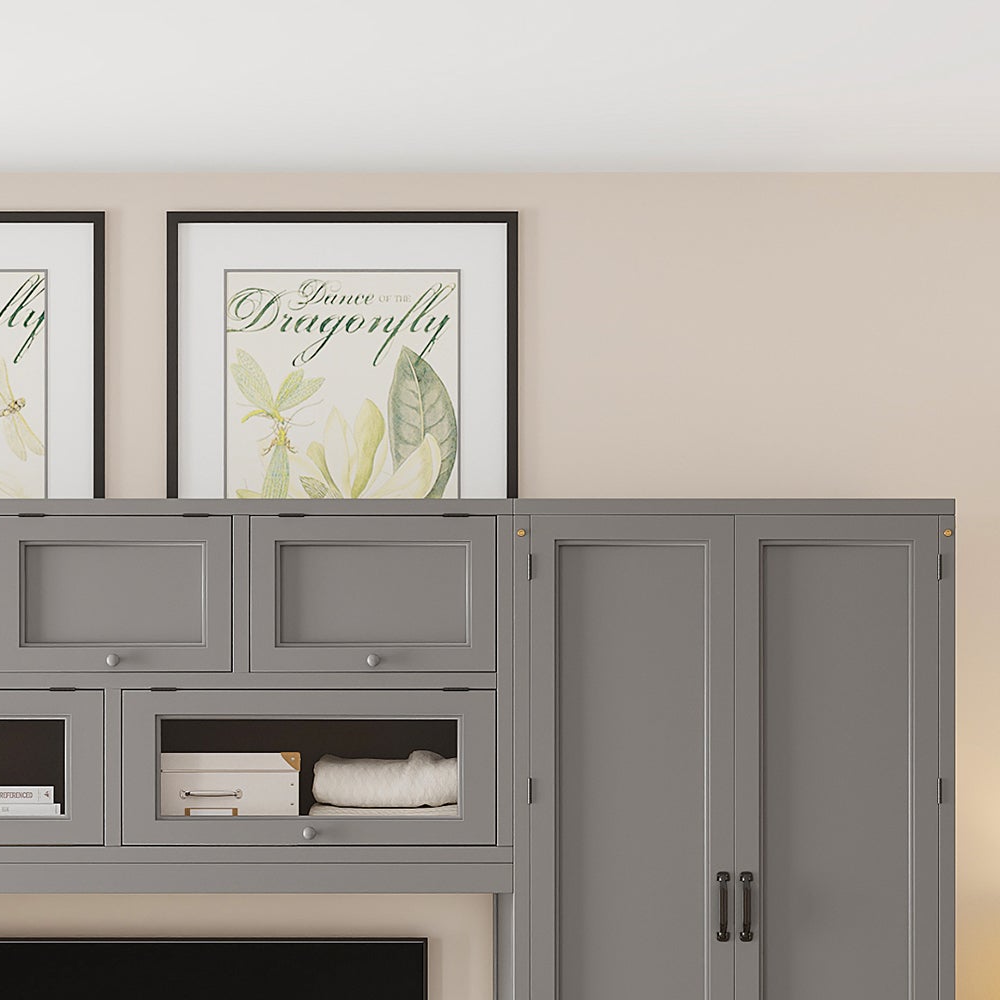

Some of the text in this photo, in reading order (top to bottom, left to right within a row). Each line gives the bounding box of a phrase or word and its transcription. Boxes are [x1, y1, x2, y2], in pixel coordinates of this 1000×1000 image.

[298, 278, 412, 305] Dance OF THE
[226, 282, 456, 367] Dragonfly
